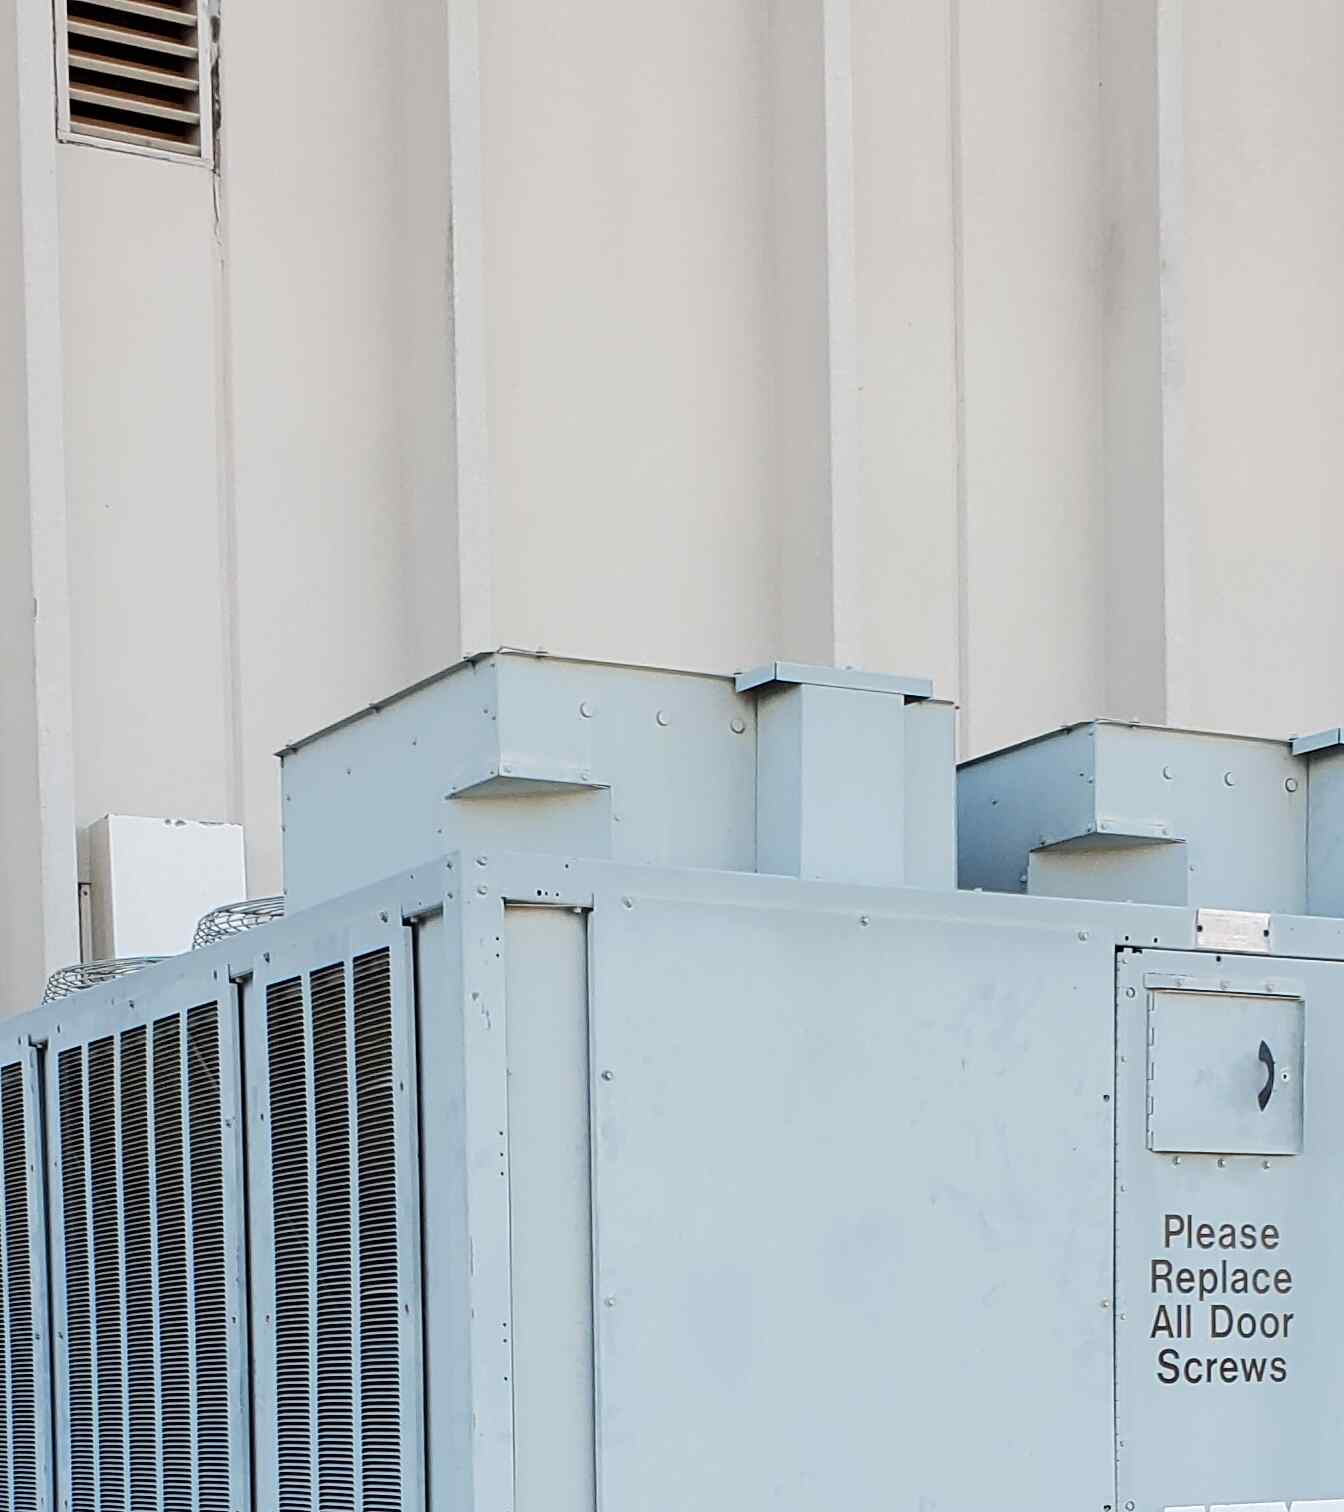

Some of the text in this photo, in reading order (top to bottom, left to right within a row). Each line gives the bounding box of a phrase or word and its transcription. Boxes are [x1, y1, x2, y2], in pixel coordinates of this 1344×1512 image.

[1164, 1214, 1280, 1249] Please
[1151, 1259, 1293, 1301] Replace
[1150, 1304, 1294, 1338] All Door
[1157, 1348, 1287, 1384] Screws
